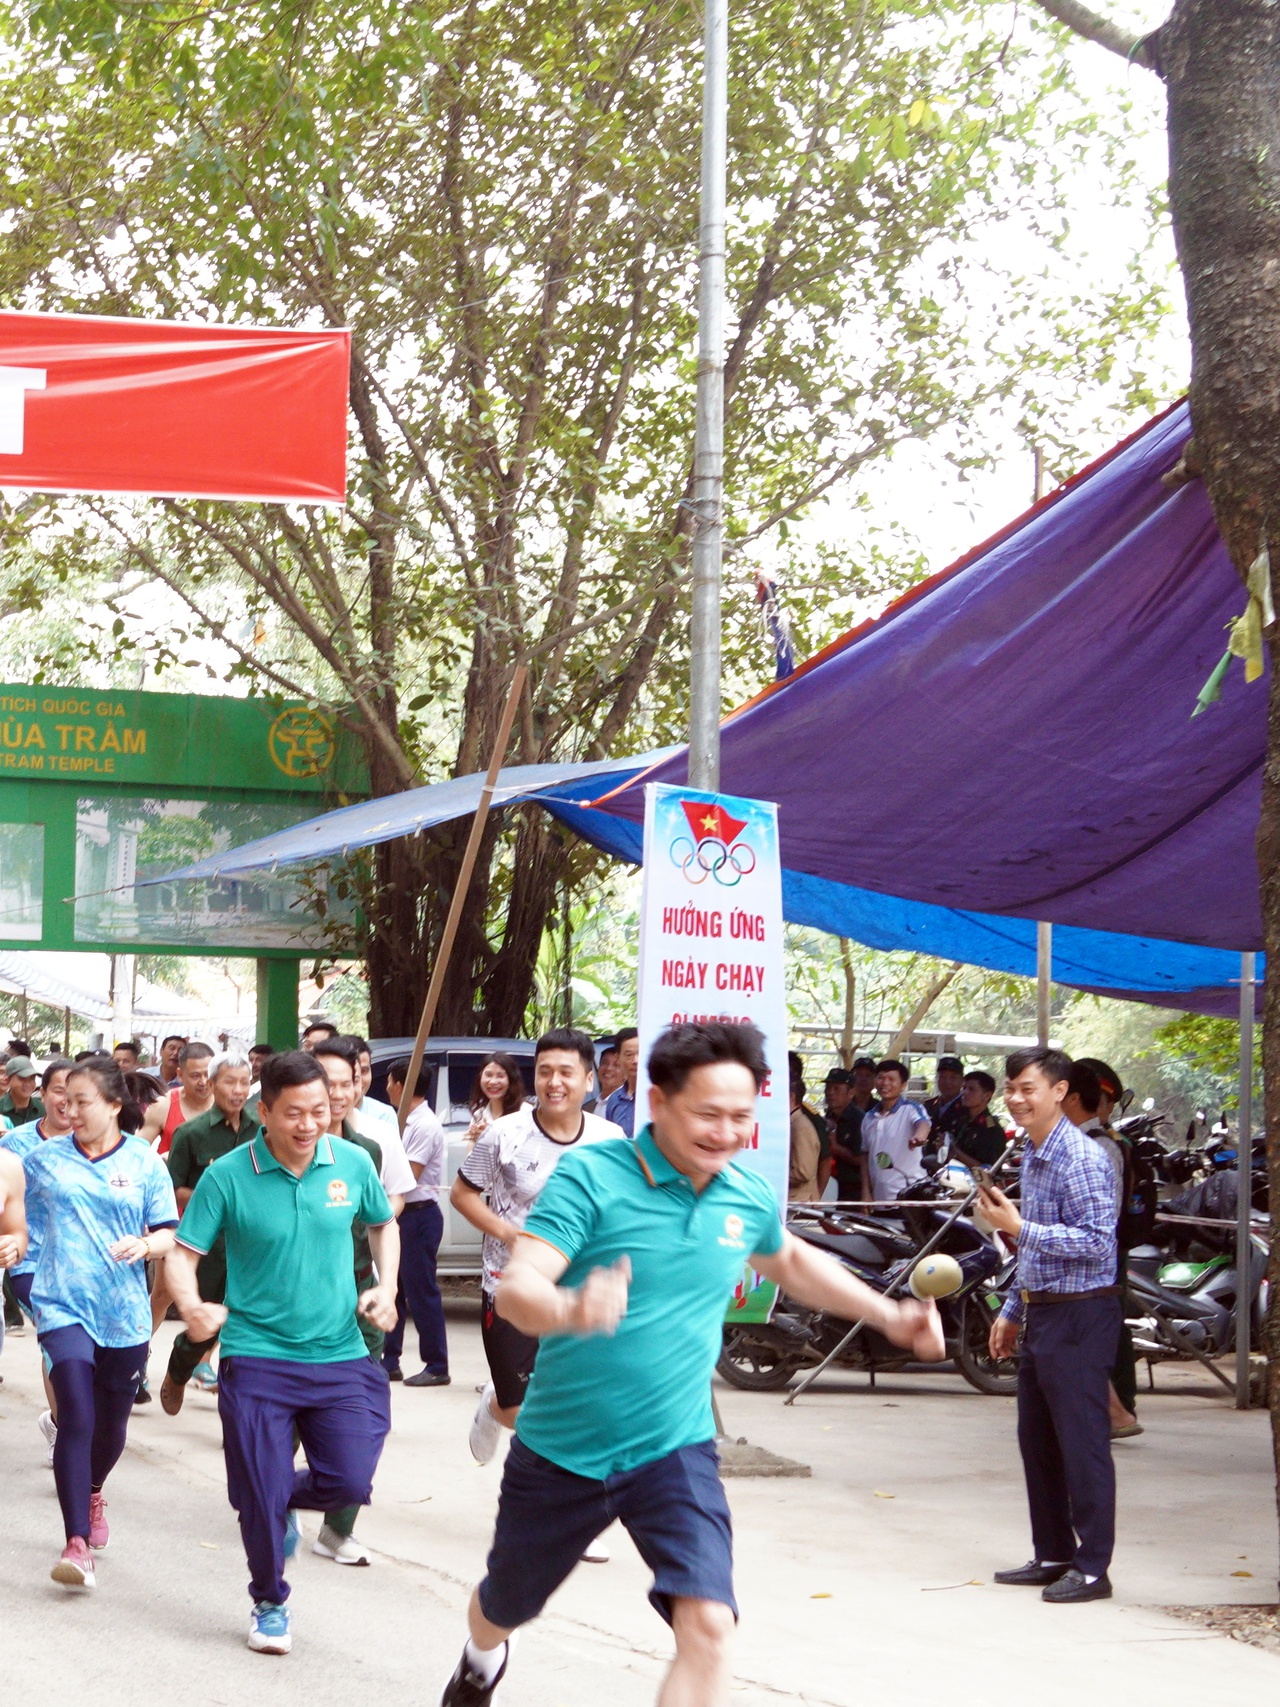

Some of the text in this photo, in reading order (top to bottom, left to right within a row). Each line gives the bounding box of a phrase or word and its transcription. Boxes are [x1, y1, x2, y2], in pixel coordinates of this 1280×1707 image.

[95, 700, 126, 717] GIA
[47, 755, 115, 774] TEMPLE
[662, 899, 765, 942] HƯỞNG ỨNG
[662, 955, 765, 998] NGÀY CHẠY
